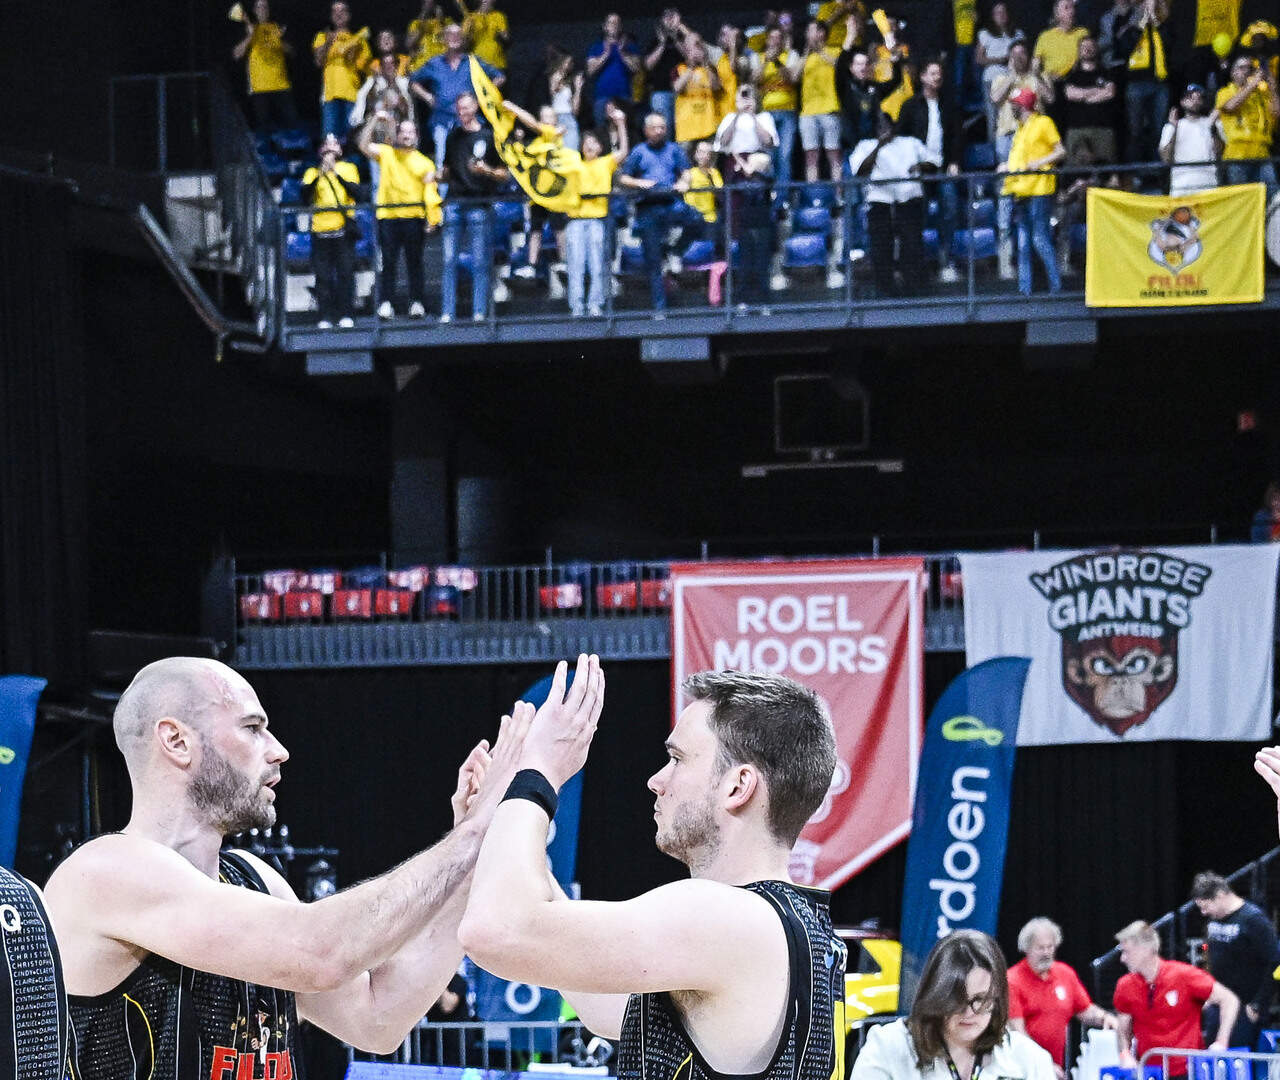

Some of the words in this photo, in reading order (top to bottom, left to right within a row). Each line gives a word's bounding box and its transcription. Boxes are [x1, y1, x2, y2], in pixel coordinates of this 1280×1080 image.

[1031, 556, 1210, 594] WINDROSE
[736, 596, 863, 633] ROEL
[1050, 588, 1190, 630] GIANTS
[1078, 622, 1164, 642] ANTWERP
[719, 638, 888, 675] MOORS
